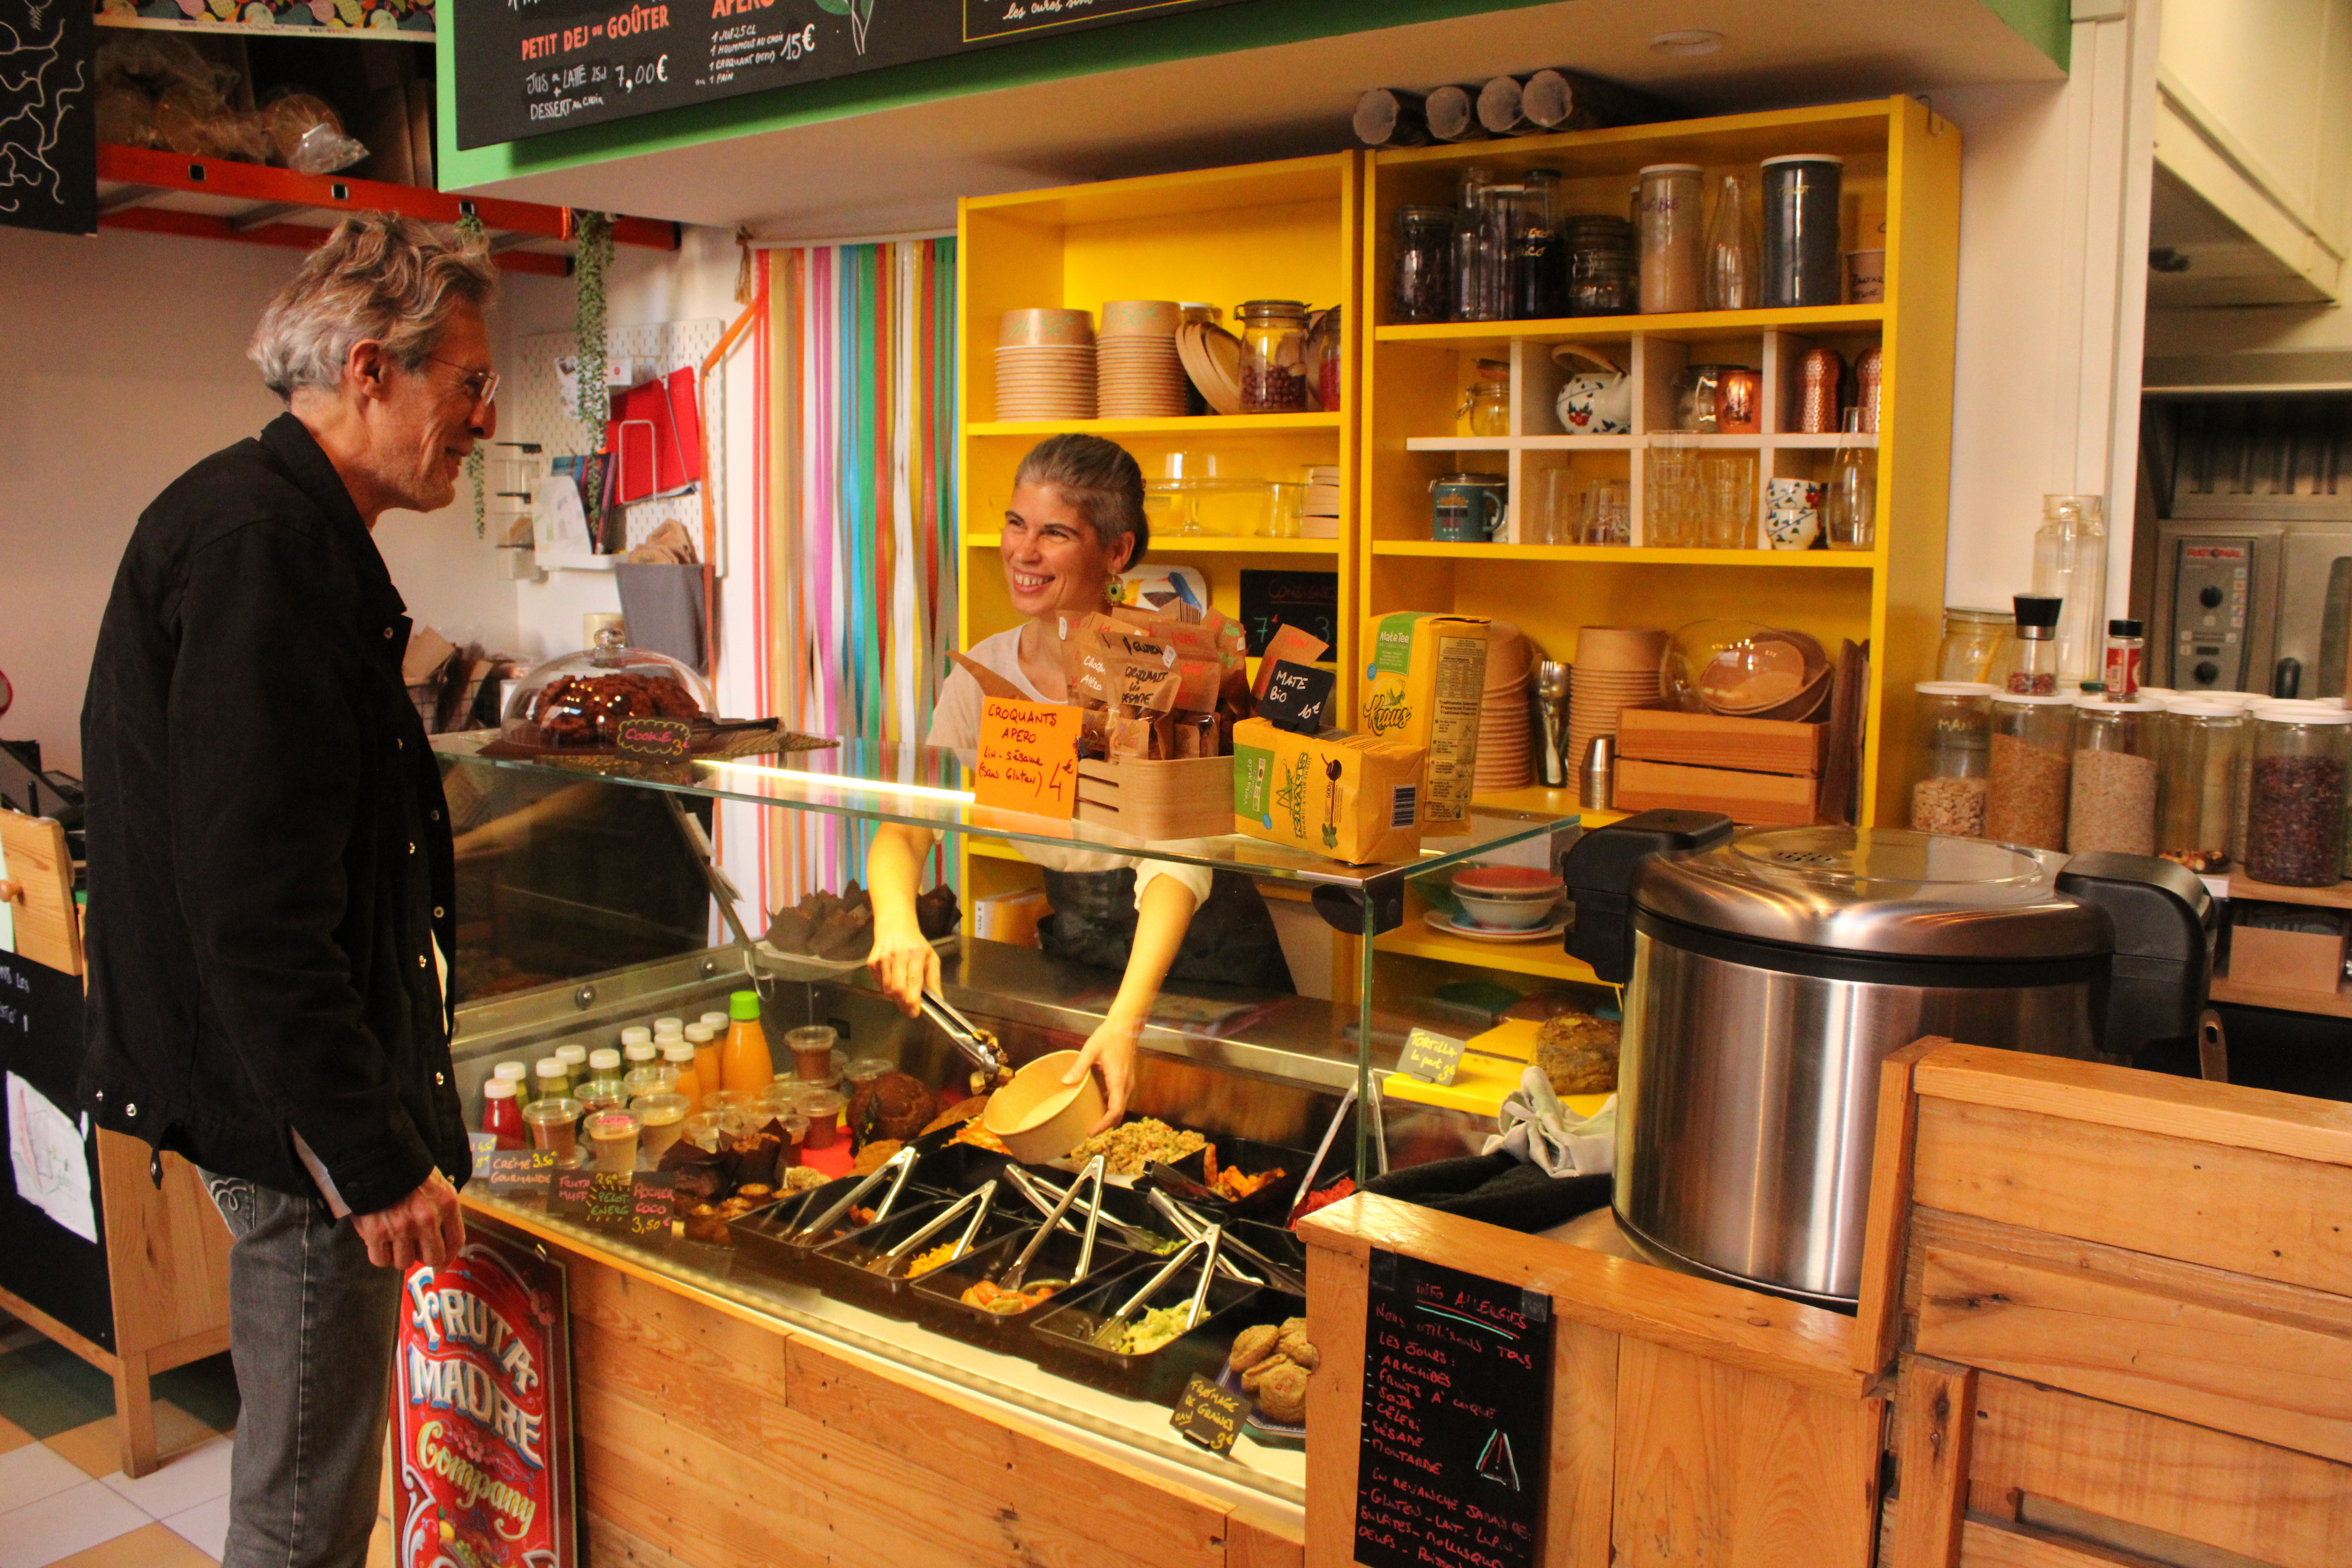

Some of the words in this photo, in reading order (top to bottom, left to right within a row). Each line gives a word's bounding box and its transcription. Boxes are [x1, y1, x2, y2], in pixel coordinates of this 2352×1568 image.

[522, 33, 557, 60] PETIT
[563, 25, 588, 52] DEJ
[607, 4, 670, 39] GOÛTER
[711, 31, 719, 43] 1
[780, 23, 815, 60] 15€
[710, 45, 716, 56] 1
[709, 61, 715, 71] 1
[526, 72, 550, 94] JUS
[709, 75, 715, 84] 1
[530, 98, 572, 120] DESSERT
[1379, 631, 1397, 642] Mate
[1398, 632, 1410, 644] Tee
[1276, 670, 1308, 690] MATE
[988, 704, 1057, 726] CROQUANTS
[1363, 694, 1411, 736] Kraus
[1002, 728, 1036, 744] APERO
[408, 1266, 539, 1396] FRUTA
[408, 1341, 544, 1470] MADRE
[1190, 1380, 1239, 1413] FROMAGE
[417, 1420, 536, 1541] Company
